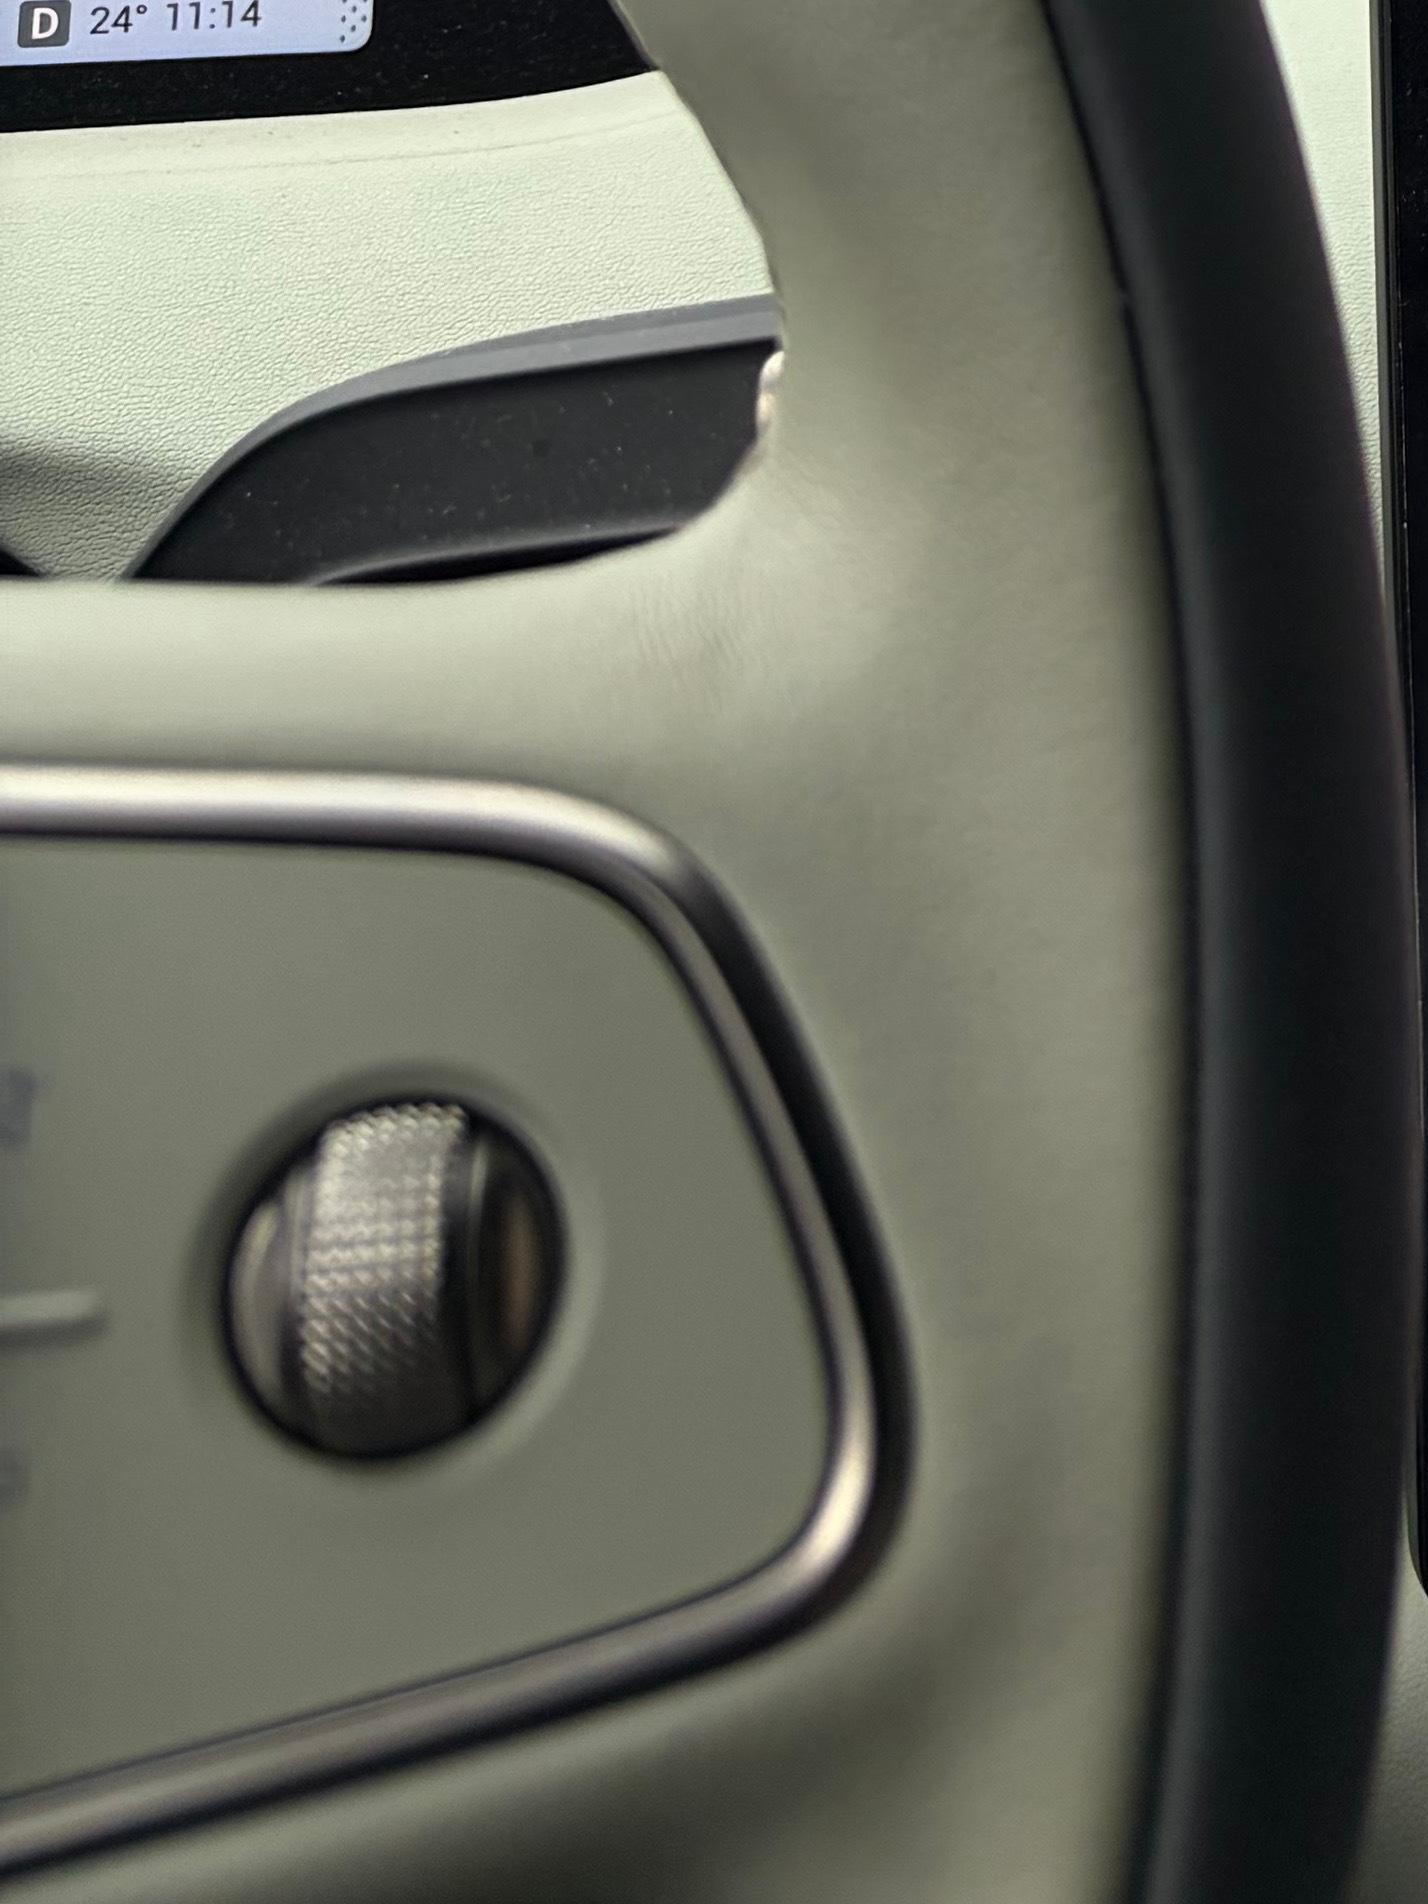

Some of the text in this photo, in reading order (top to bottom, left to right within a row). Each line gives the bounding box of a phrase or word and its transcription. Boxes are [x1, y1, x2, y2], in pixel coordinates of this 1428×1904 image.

[31, 0, 262, 39] D 24° 11:14
